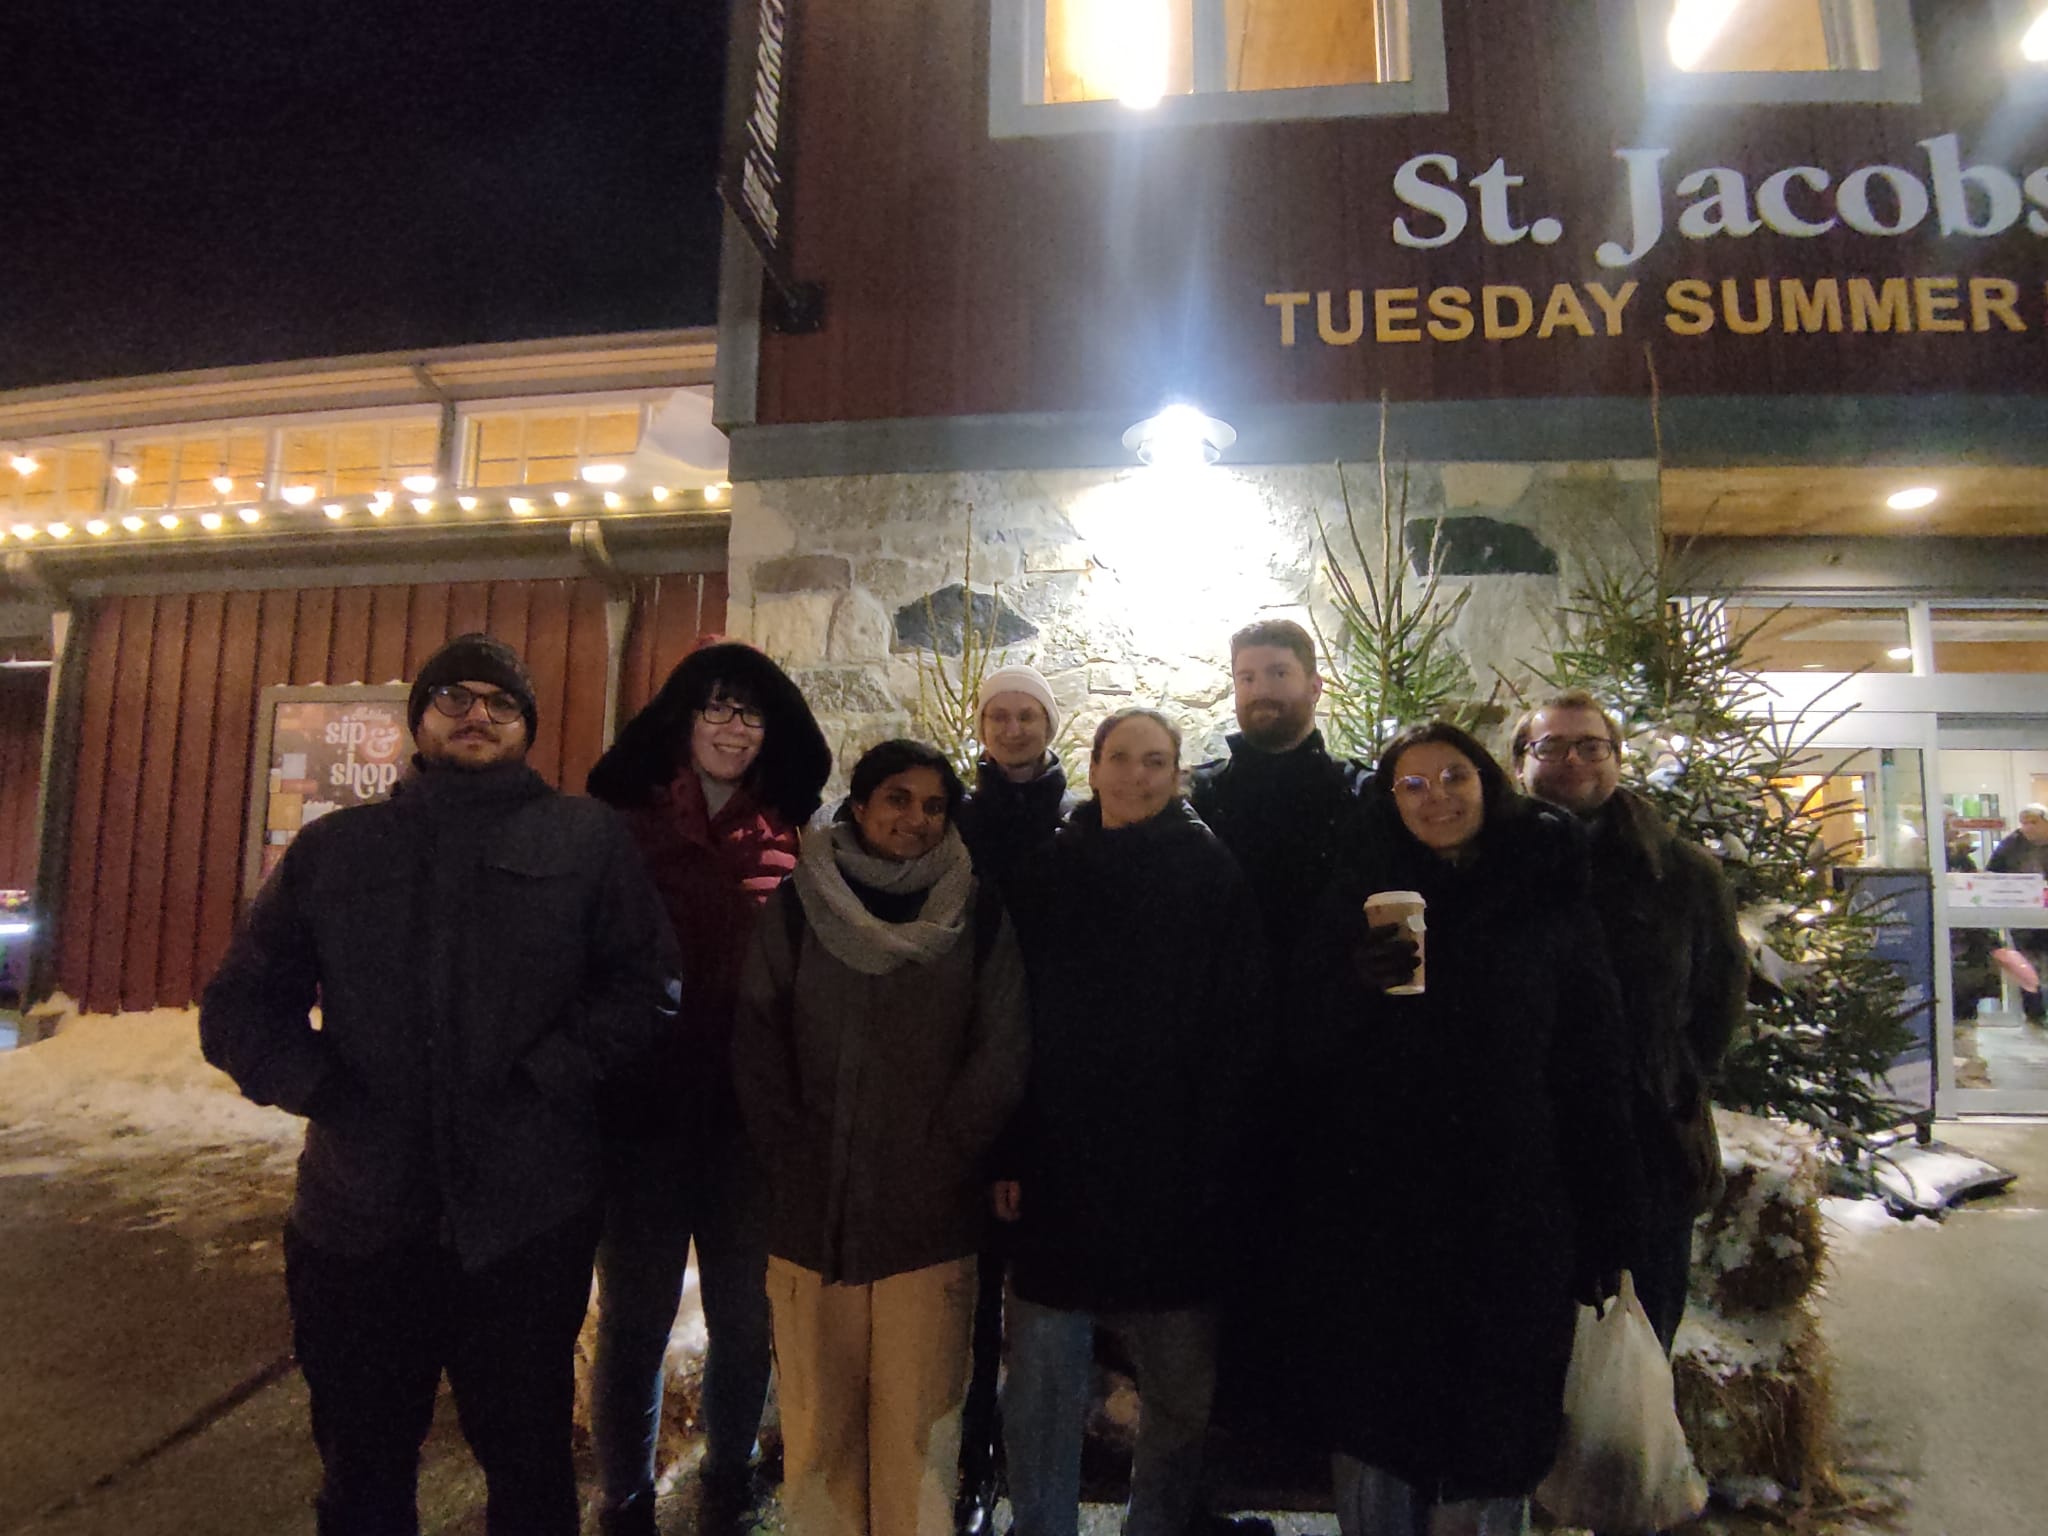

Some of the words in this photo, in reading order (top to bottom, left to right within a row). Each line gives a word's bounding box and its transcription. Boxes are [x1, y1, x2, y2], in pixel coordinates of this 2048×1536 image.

[1392, 153, 1562, 249] St.
[1264, 281, 1640, 347] TUESDAY
[1664, 276, 2028, 336] SUMMER
[324, 716, 366, 752] sip
[366, 726, 401, 759] &
[330, 753, 398, 799] shop
